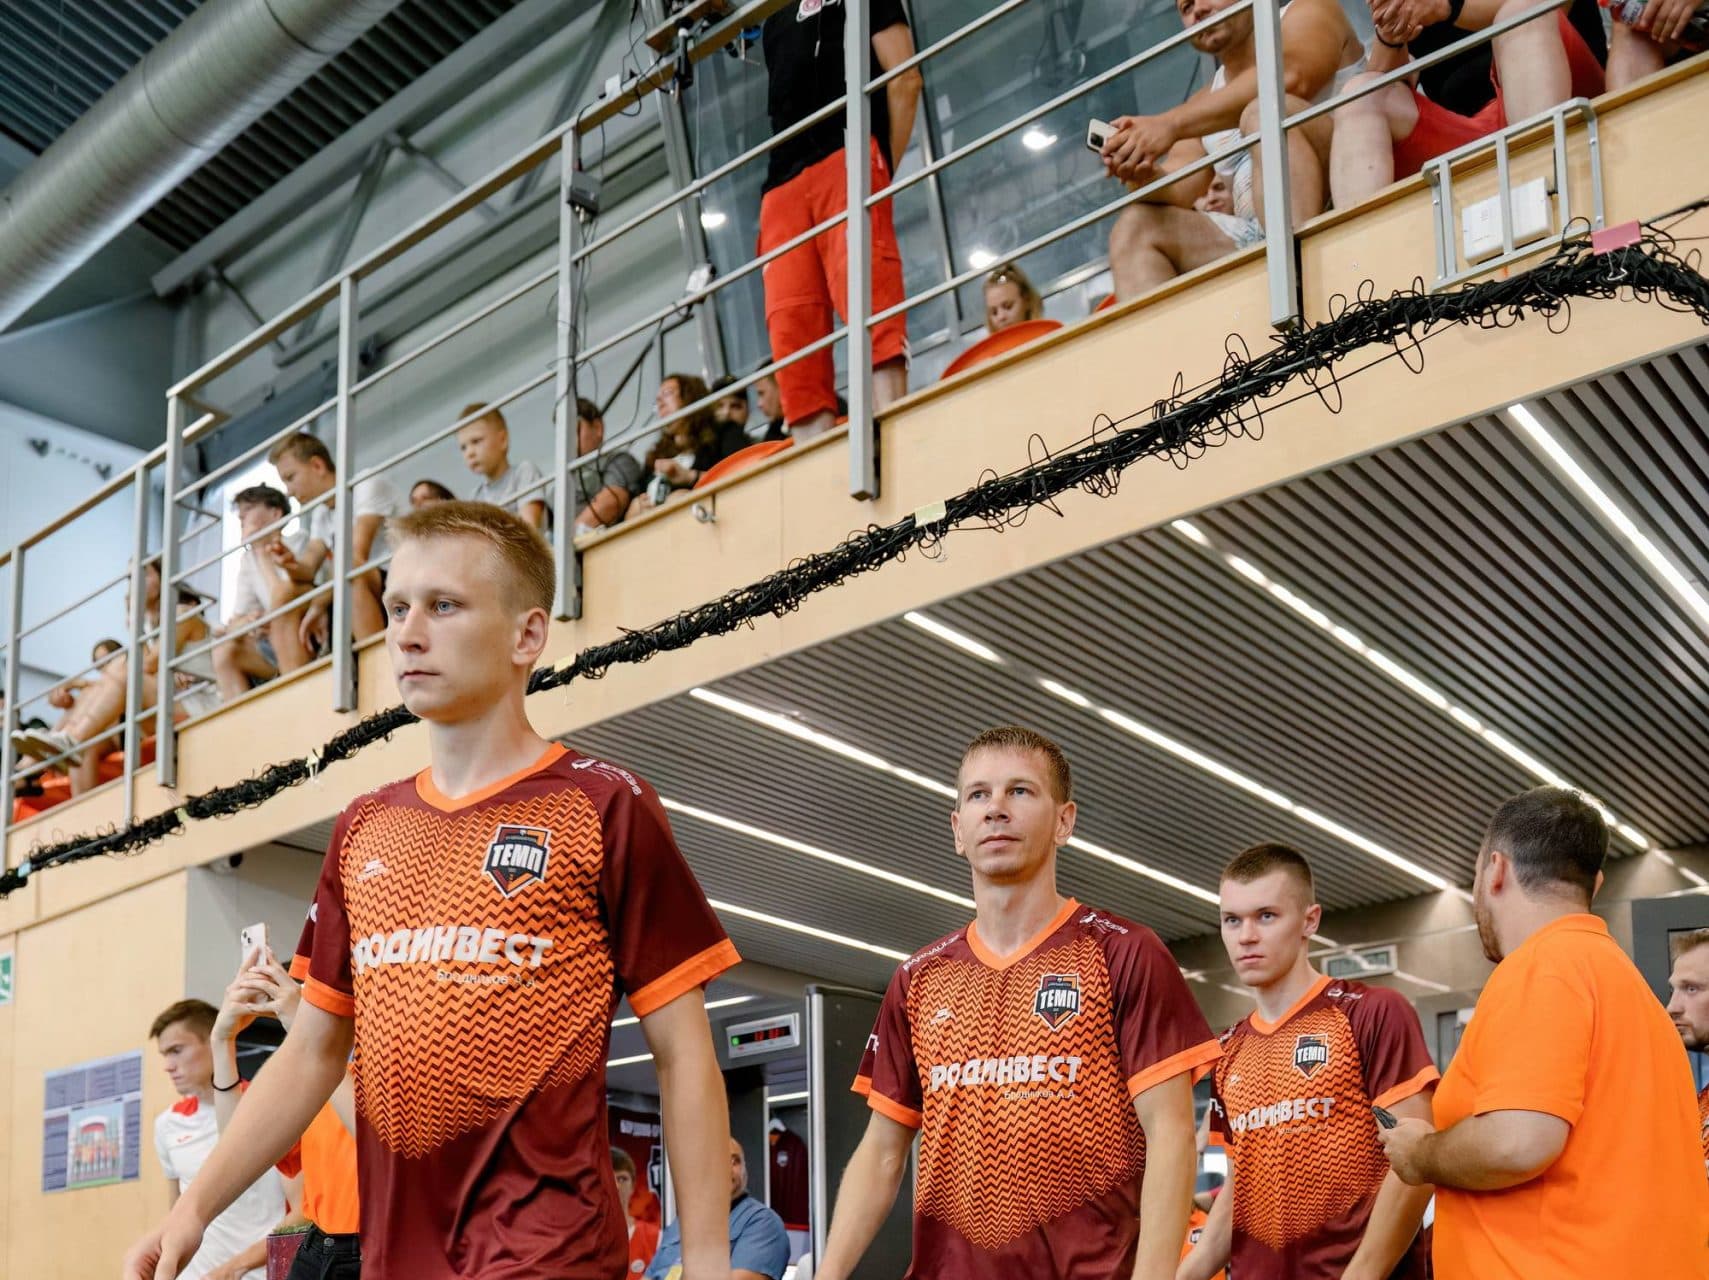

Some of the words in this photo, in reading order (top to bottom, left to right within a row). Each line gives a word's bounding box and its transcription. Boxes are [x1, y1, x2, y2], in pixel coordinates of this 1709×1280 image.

[491, 843, 544, 872] ТЕМП
[1040, 989, 1077, 1010] ТЕМП
[1297, 1045, 1326, 1063] ТЕМП
[929, 1055, 1082, 1092] РОДИНВЕСТ
